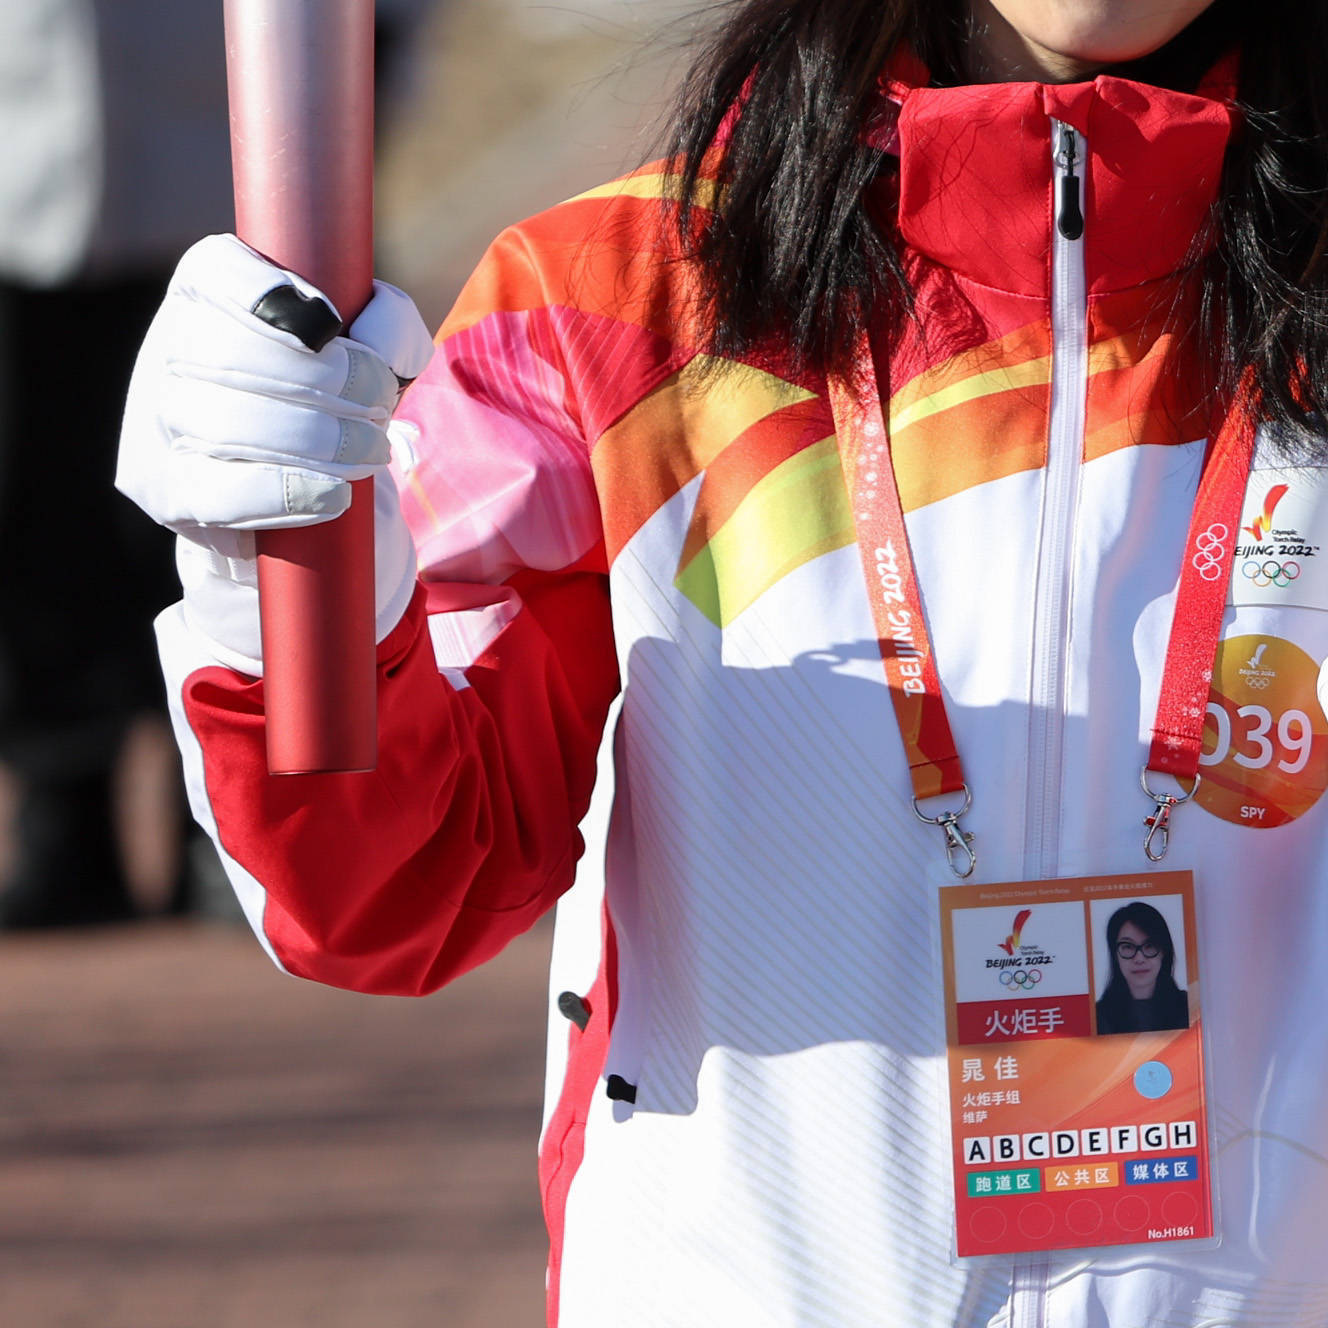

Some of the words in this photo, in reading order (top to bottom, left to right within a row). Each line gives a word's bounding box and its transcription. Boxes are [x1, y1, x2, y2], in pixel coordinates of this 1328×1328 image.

[1234, 545, 1274, 559] EIJING
[873, 539, 905, 605] 2022
[893, 608, 926, 698] BEIJING
[1200, 701, 1313, 774] 039
[1240, 805, 1266, 821] SPY
[985, 958, 1022, 969] BEIJING
[1025, 956, 1053, 965] 2022
[984, 1006, 1064, 1038] 火炬手
[962, 1090, 1021, 1108] 火炬手组
[976, 1174, 1032, 1192] 跑道区
[1054, 1167, 1110, 1186] 公共区
[1132, 1161, 1189, 1181] 媒体区
[1147, 1226, 1195, 1239] No.H1861
